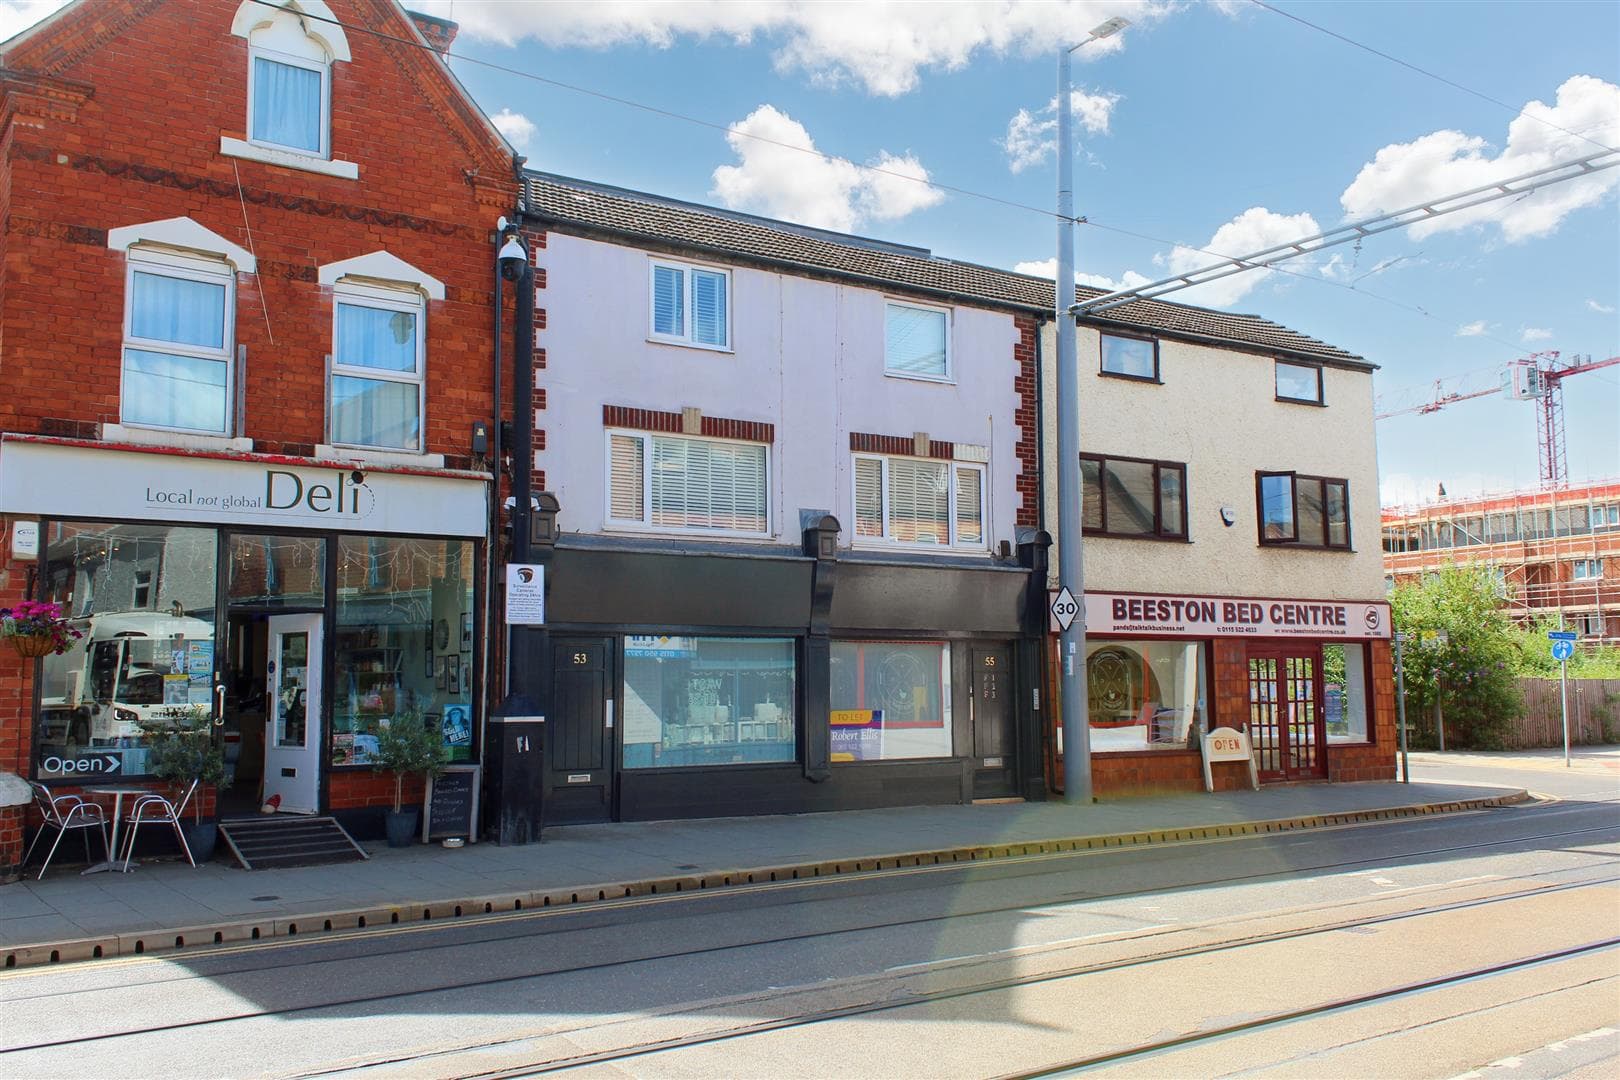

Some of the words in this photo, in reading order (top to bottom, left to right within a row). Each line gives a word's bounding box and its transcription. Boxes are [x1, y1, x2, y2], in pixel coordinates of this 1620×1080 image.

[146, 487, 193, 505] Local
[196, 495, 218, 506] not
[222, 494, 261, 510] global
[266, 470, 363, 514] Deli
[1056, 602, 1075, 615] 30
[1112, 598, 1216, 622] BEESTON
[1222, 602, 1264, 624] BED
[1269, 603, 1347, 626] CENTRE
[573, 653, 587, 664] 53
[985, 656, 995, 666] 55
[838, 713, 848, 721] TO
[851, 712, 864, 720] LET
[832, 727, 858, 741] Robert
[861, 727, 879, 741] Ellis
[1214, 739, 1241, 751] OPEN
[44, 756, 103, 776] Open
